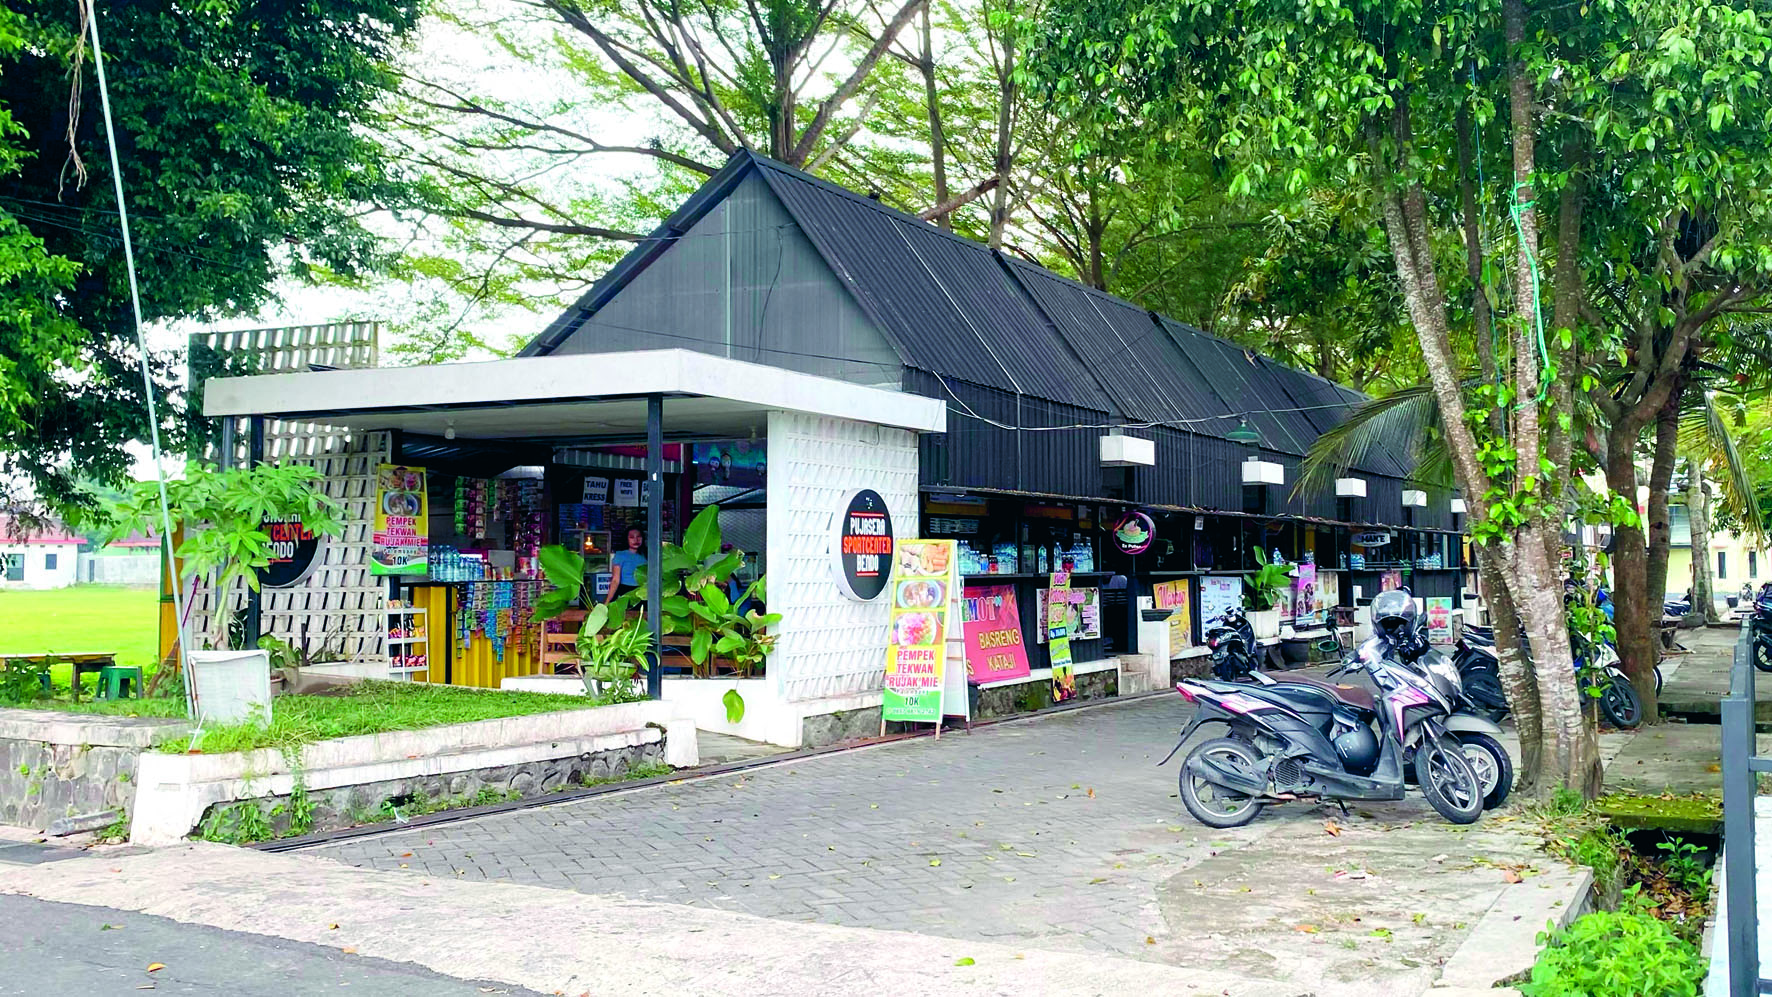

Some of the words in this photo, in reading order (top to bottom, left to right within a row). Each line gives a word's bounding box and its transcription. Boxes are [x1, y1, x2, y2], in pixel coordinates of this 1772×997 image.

[583, 493, 606, 501] KRESS
[386, 517, 417, 526] PEMPEK
[850, 517, 886, 536] PUJASERA
[386, 528, 417, 536] TEKWAN
[842, 536, 892, 554] SPORTCENTER
[392, 555, 408, 566] 10K
[856, 554, 879, 572] BENDO
[978, 628, 1020, 649] BASRENG
[896, 650, 935, 661] PEMPEK
[986, 653, 1017, 672] KATAJI
[896, 663, 934, 674] TEKWAN
[888, 676, 918, 688] RUJAK
[921, 677, 939, 688] MIE
[904, 696, 920, 706] 10K
